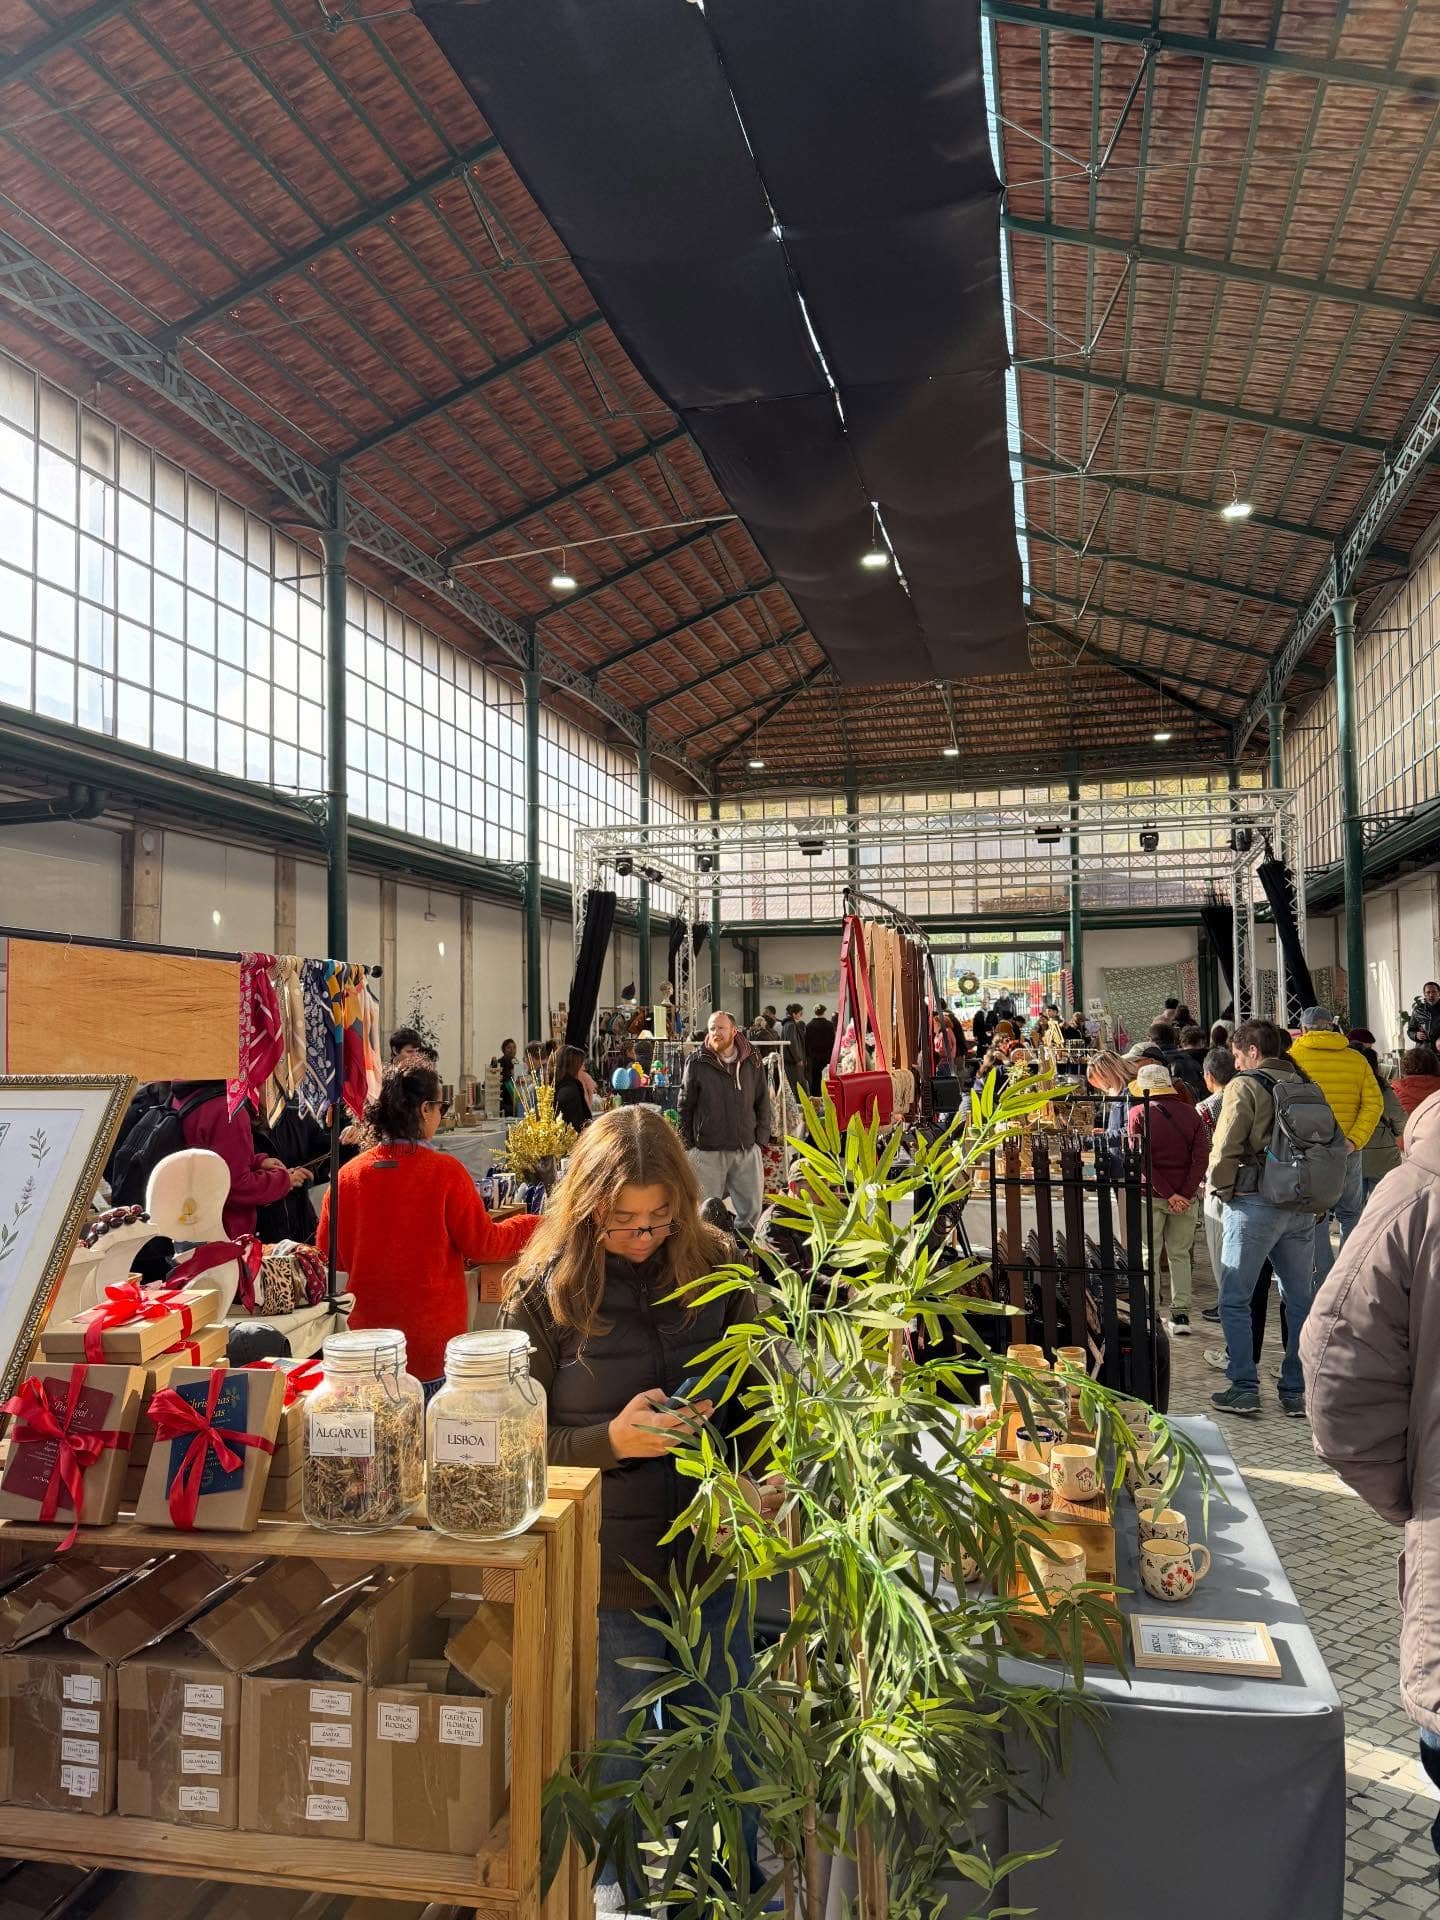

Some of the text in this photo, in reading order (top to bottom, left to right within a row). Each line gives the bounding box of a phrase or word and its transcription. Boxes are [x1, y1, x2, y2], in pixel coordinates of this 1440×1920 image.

[316, 1427, 368, 1439] ALGARVE
[447, 1434, 485, 1446] LISBOA
[385, 1714, 413, 1723] TROPICAL
[385, 1721, 412, 1730] ROOIBOS
[446, 1721, 475, 1730] FLOWERS
[454, 1729, 475, 1737] FRUITS
